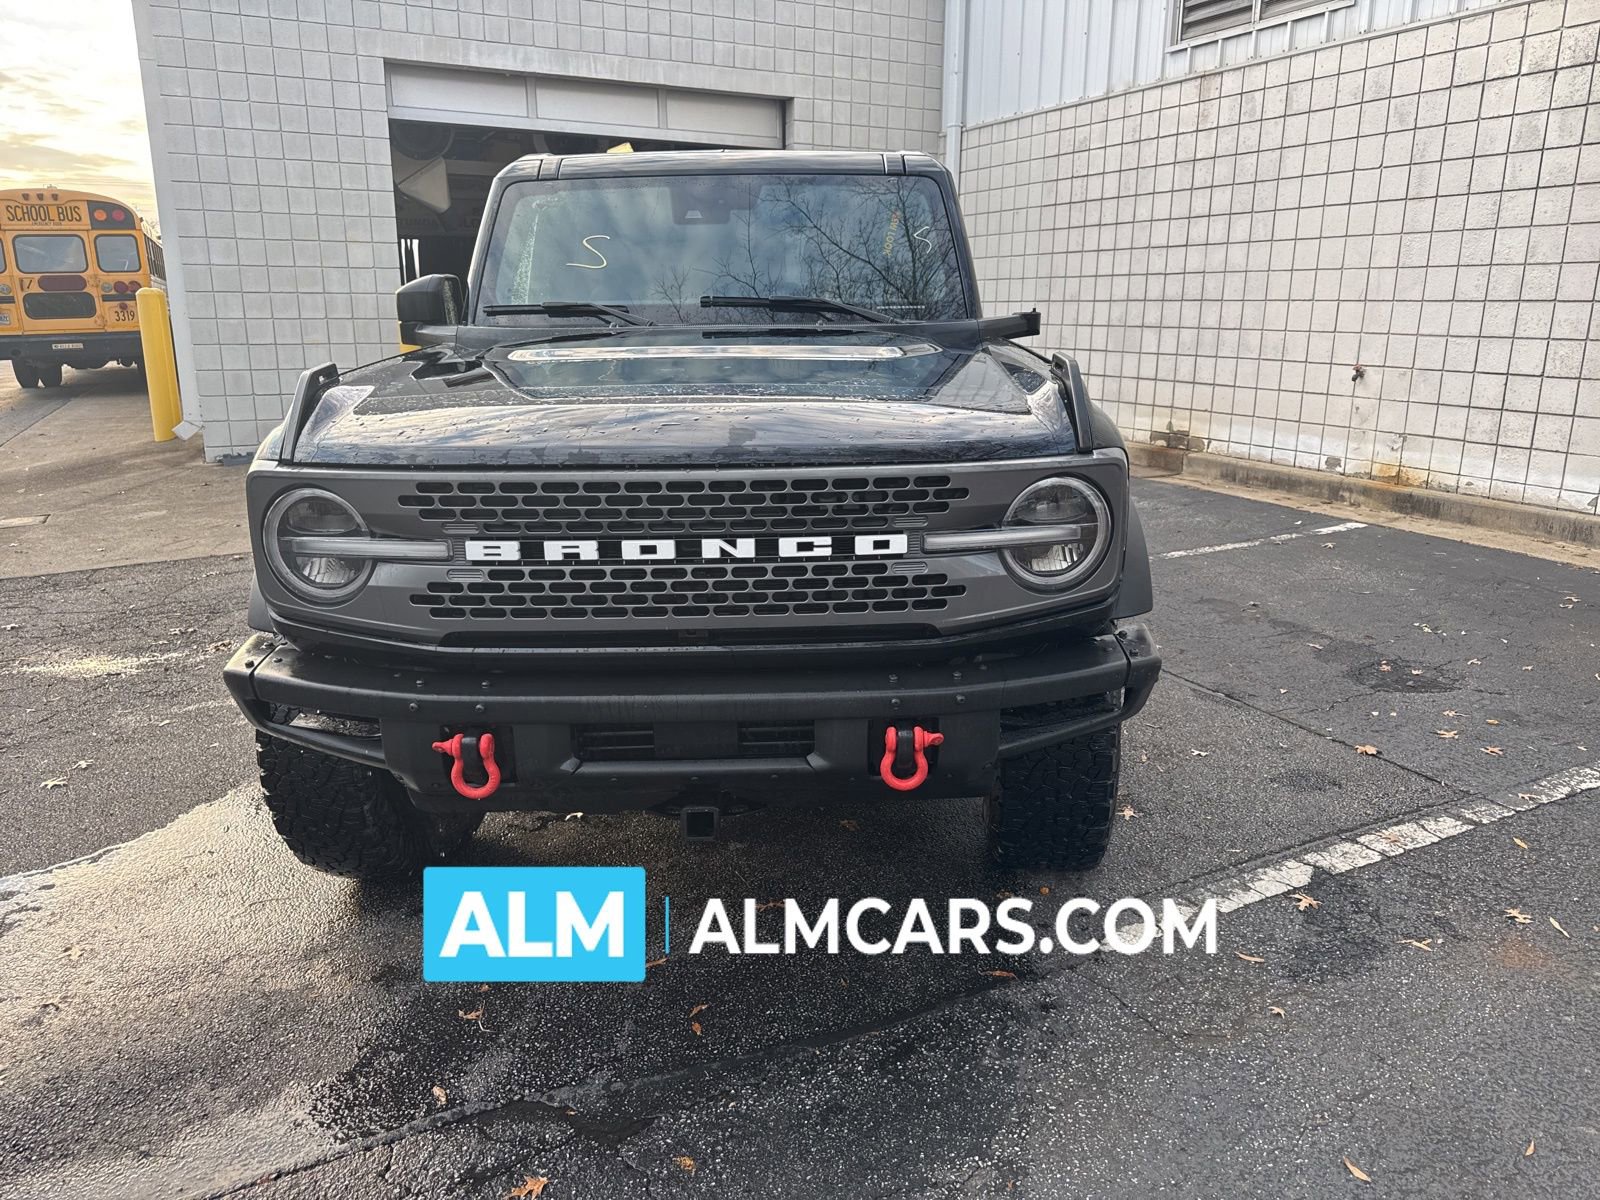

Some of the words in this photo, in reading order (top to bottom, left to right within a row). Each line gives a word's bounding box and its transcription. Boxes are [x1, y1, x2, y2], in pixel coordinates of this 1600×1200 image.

[6, 205, 55, 221] SCHOOL
[57, 206, 82, 222] BUS
[565, 234, 611, 269] S
[114, 310, 135, 322] 3319
[464, 533, 908, 561] BRONCO
